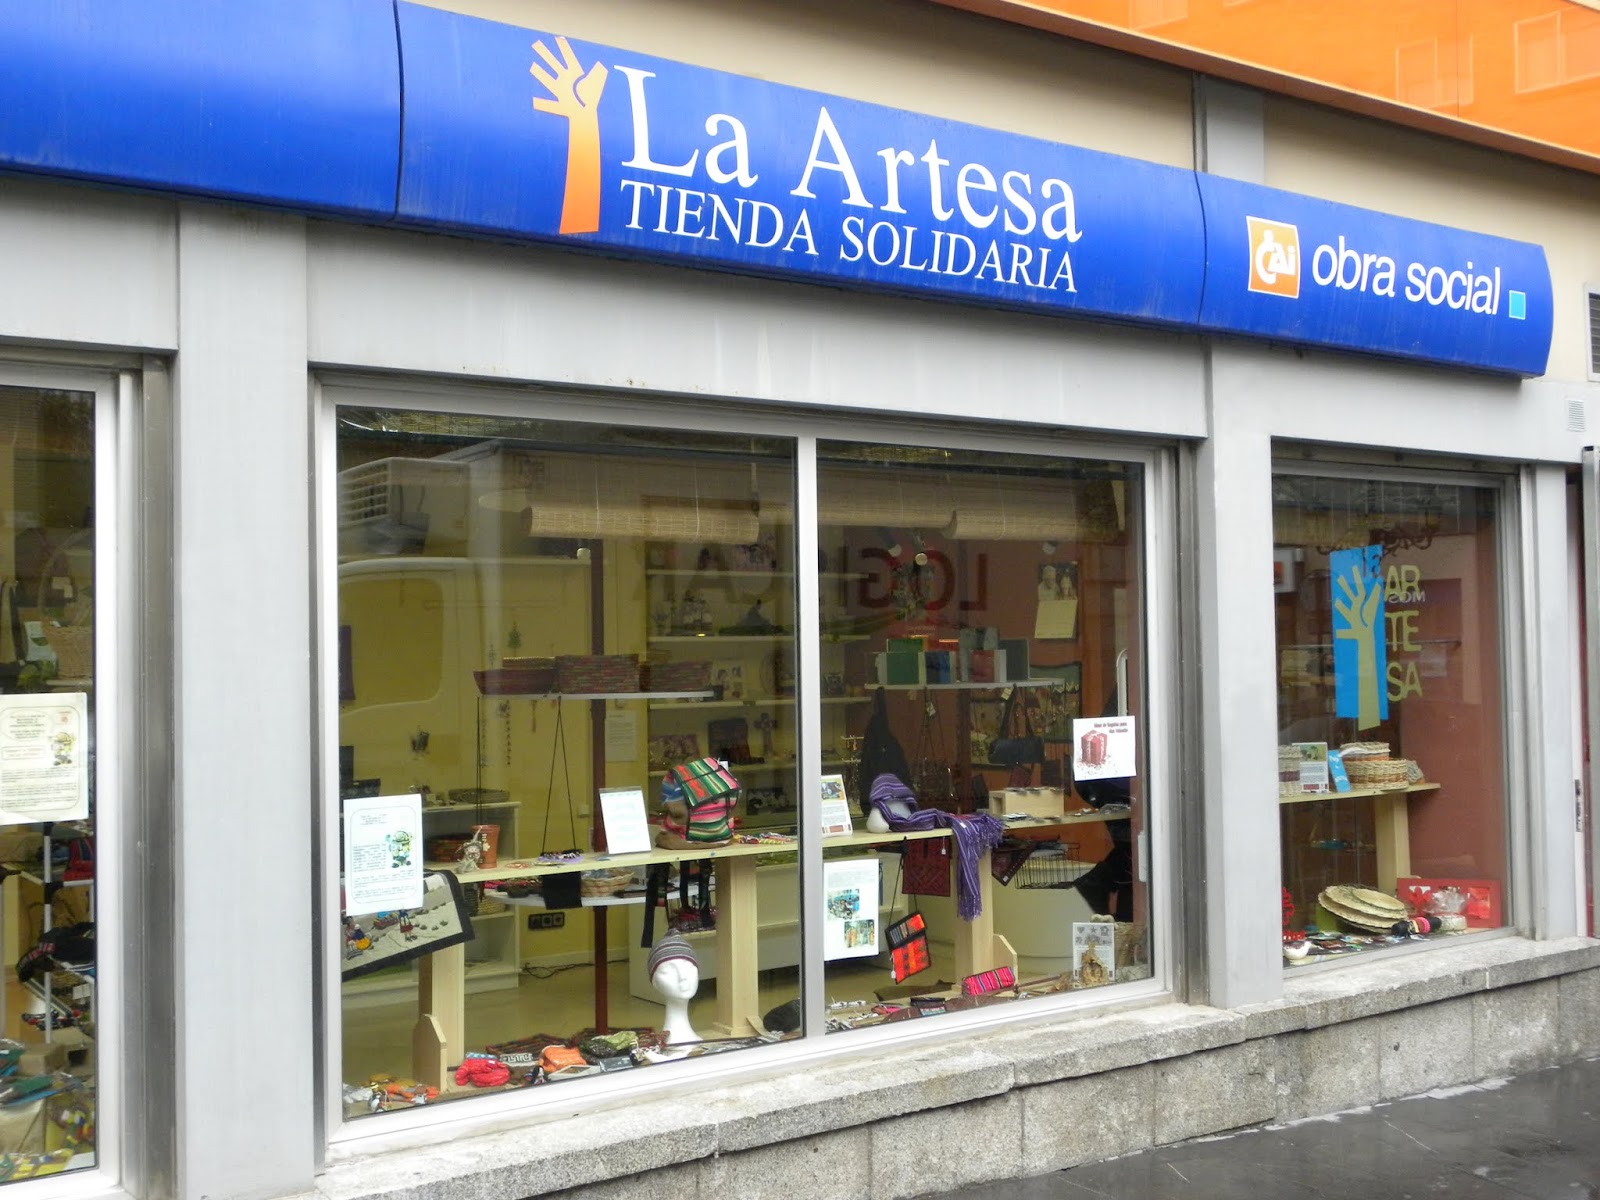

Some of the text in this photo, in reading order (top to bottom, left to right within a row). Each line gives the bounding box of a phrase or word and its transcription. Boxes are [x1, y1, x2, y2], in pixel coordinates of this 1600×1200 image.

[614, 64, 1082, 244] La Artesa
[620, 179, 1077, 295] TIENDA SOLIDARIA
[1312, 235, 1501, 316] obra social
